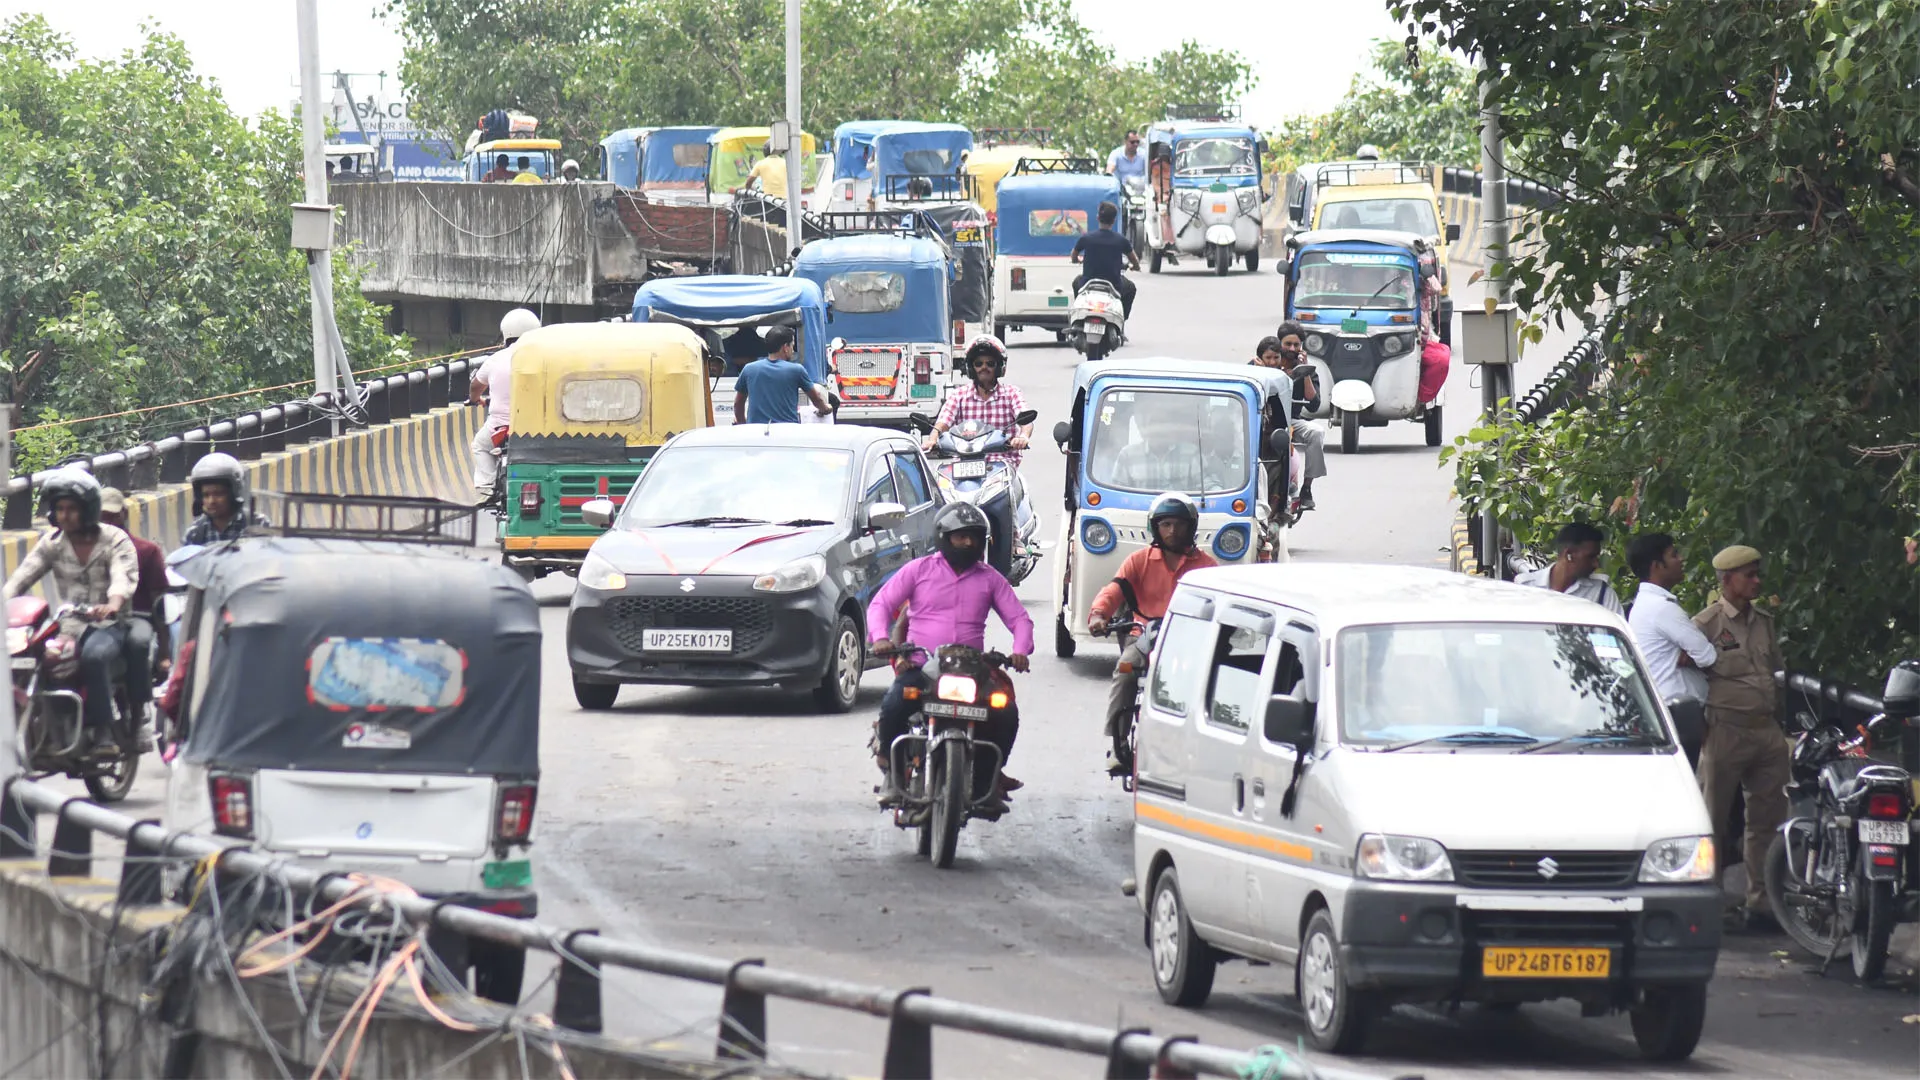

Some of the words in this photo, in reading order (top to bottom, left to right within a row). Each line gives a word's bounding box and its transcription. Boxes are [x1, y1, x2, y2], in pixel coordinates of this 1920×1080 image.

[397, 166, 422, 177] AND
[651, 633, 730, 648] UP25EK0179
[1495, 952, 1608, 972] UP24BT6187
